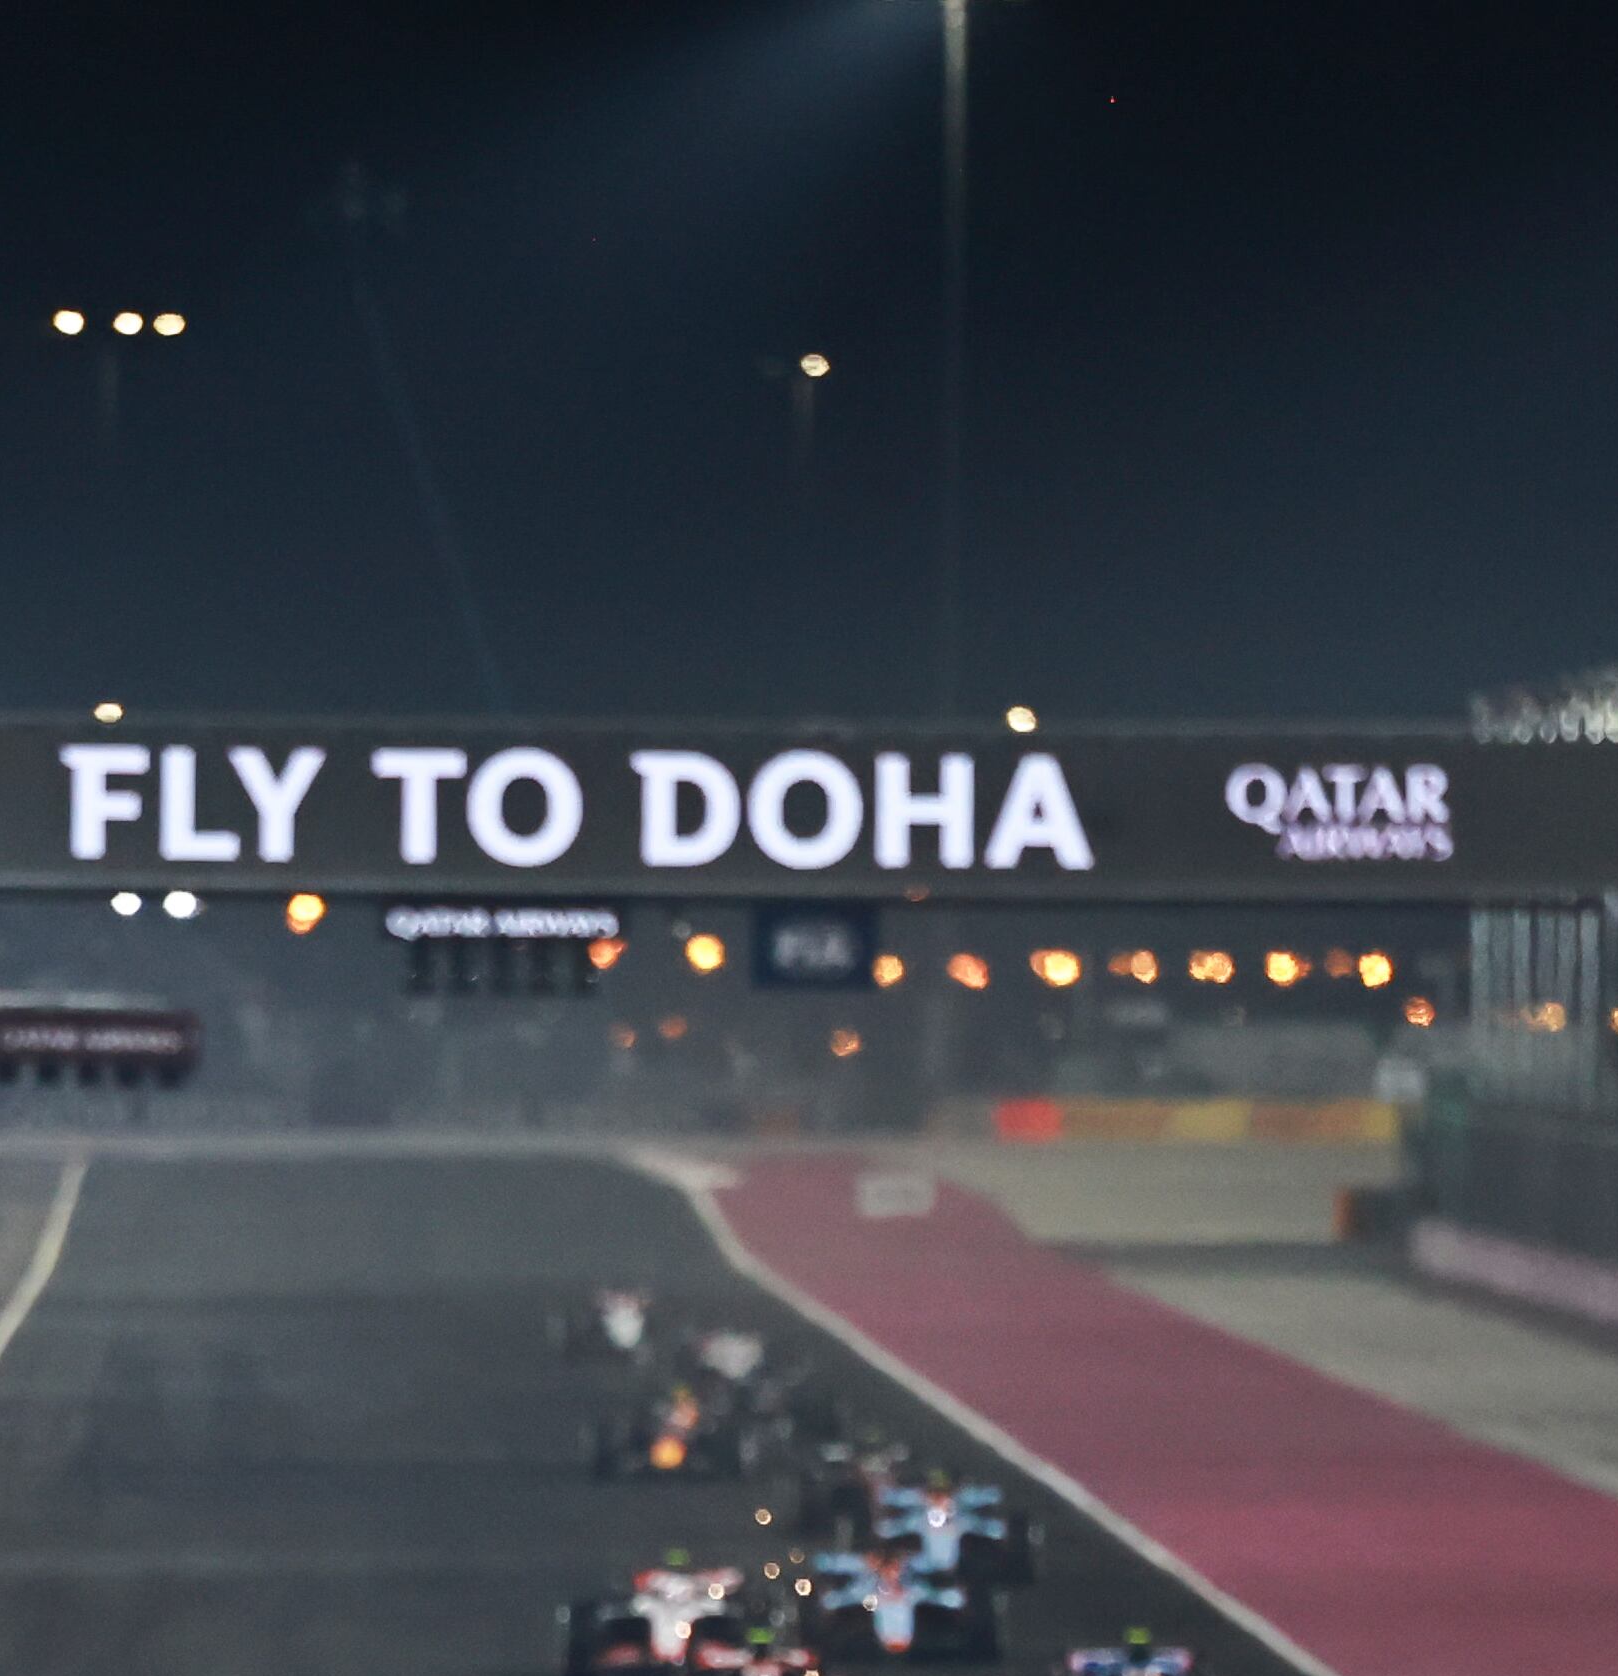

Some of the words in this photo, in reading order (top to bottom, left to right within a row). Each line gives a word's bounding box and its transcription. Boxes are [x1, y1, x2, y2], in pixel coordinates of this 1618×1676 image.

[59, 744, 326, 863] FLY
[370, 746, 584, 868] TO
[630, 747, 1095, 871] DOHA
[1225, 762, 1450, 835] QATAR
